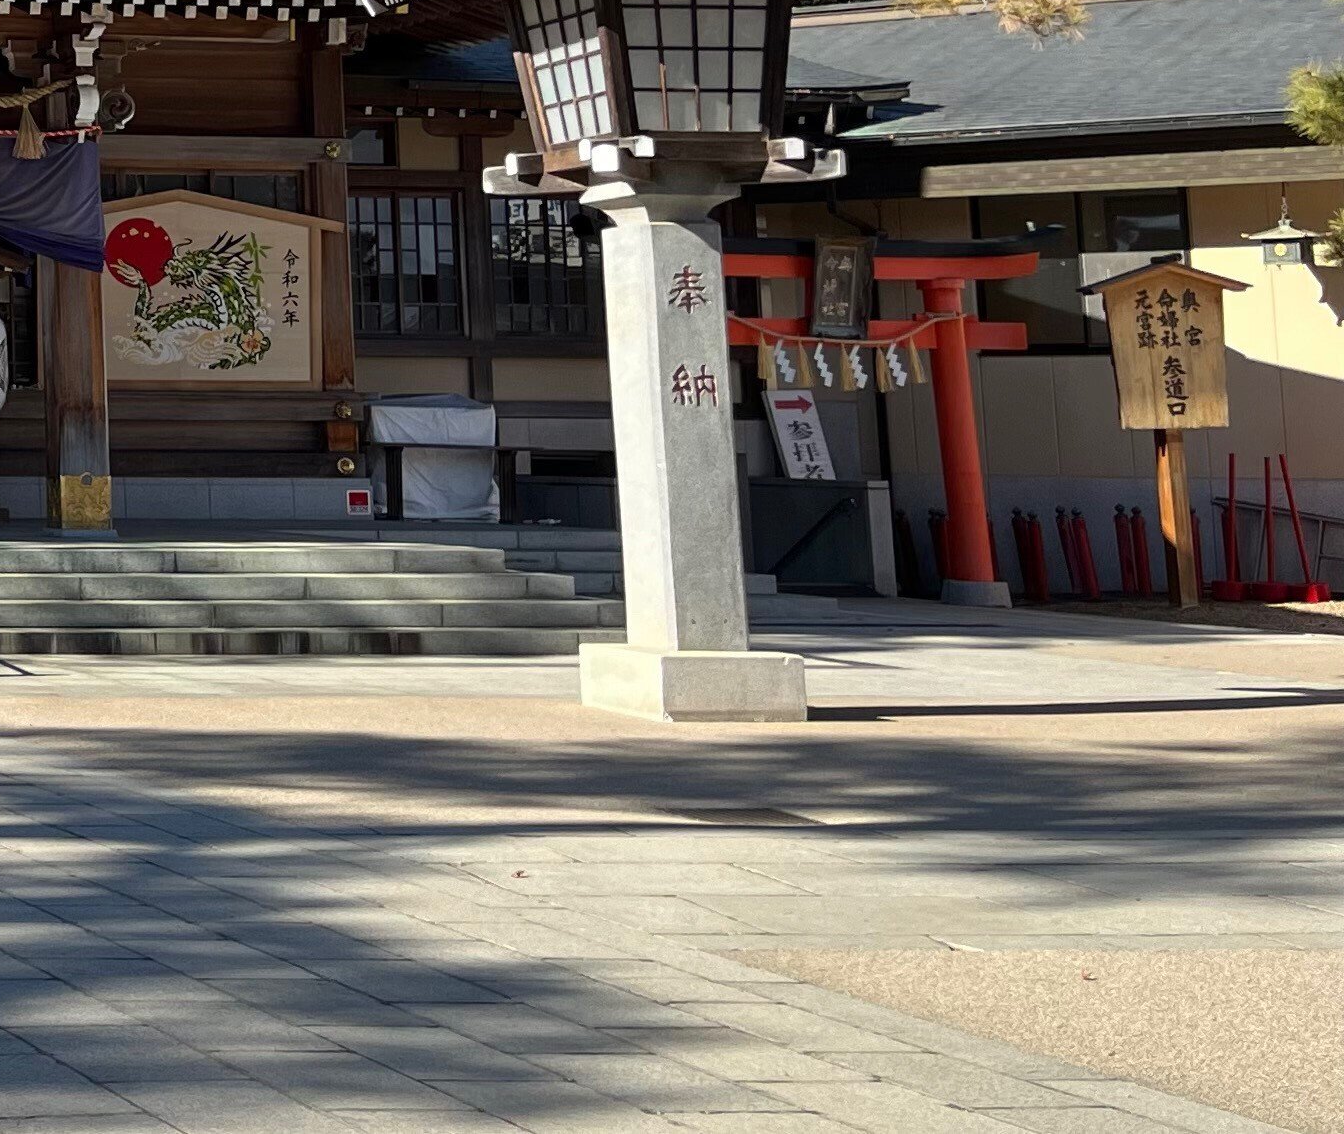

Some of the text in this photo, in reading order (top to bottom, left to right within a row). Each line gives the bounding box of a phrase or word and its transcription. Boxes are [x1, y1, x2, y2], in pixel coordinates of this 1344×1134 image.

[281, 248, 300, 328] 令和六年
[1155, 288, 1182, 349] 命婦社
[668, 265, 718, 407] 奉納
[1134, 289, 1159, 349] 元宮跡
[1162, 355, 1190, 416] 参道口
